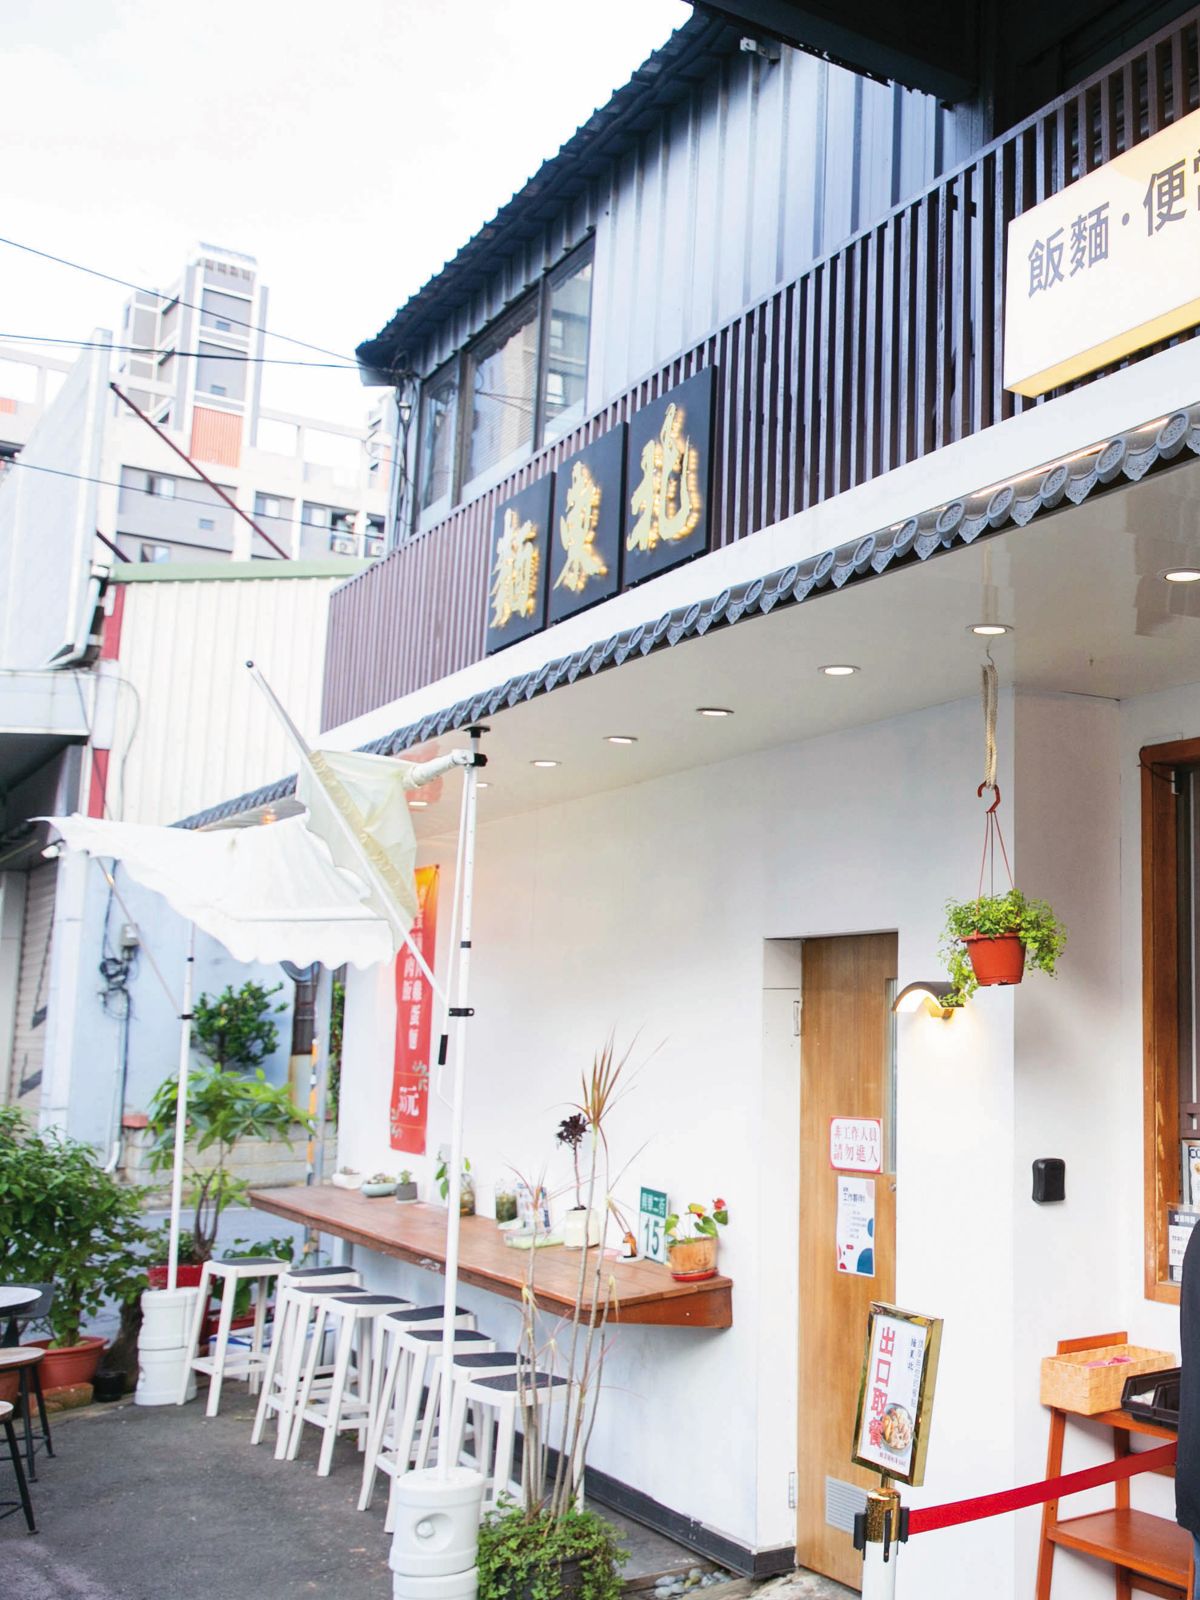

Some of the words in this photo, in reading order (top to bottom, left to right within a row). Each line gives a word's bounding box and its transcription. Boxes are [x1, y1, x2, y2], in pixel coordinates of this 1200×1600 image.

[834, 1125, 878, 1141] 非工作人員
